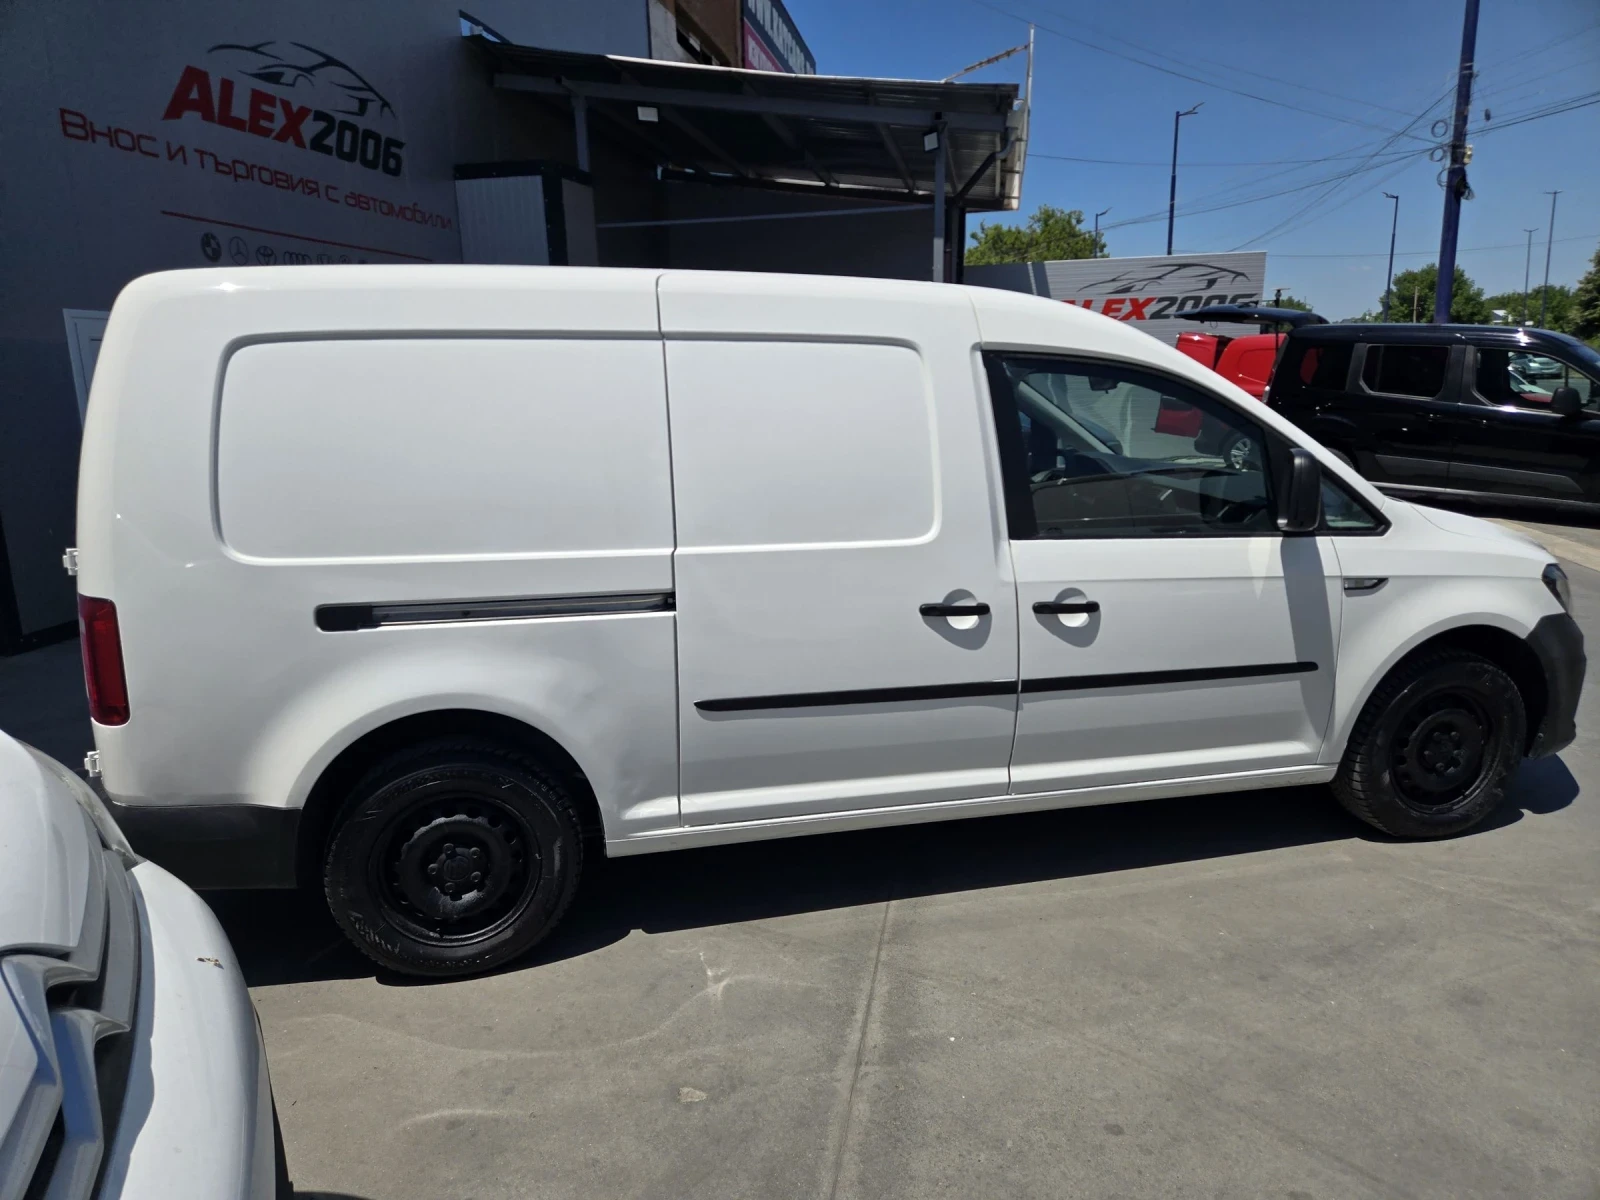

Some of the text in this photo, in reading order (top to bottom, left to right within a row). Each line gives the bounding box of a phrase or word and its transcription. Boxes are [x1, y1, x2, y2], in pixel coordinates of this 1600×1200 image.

[59, 107, 160, 159] Внос
[166, 140, 188, 165] и
[194, 148, 320, 199] търговия
[344, 191, 453, 230] автомобили
[162, 65, 406, 177] ALEX2006
